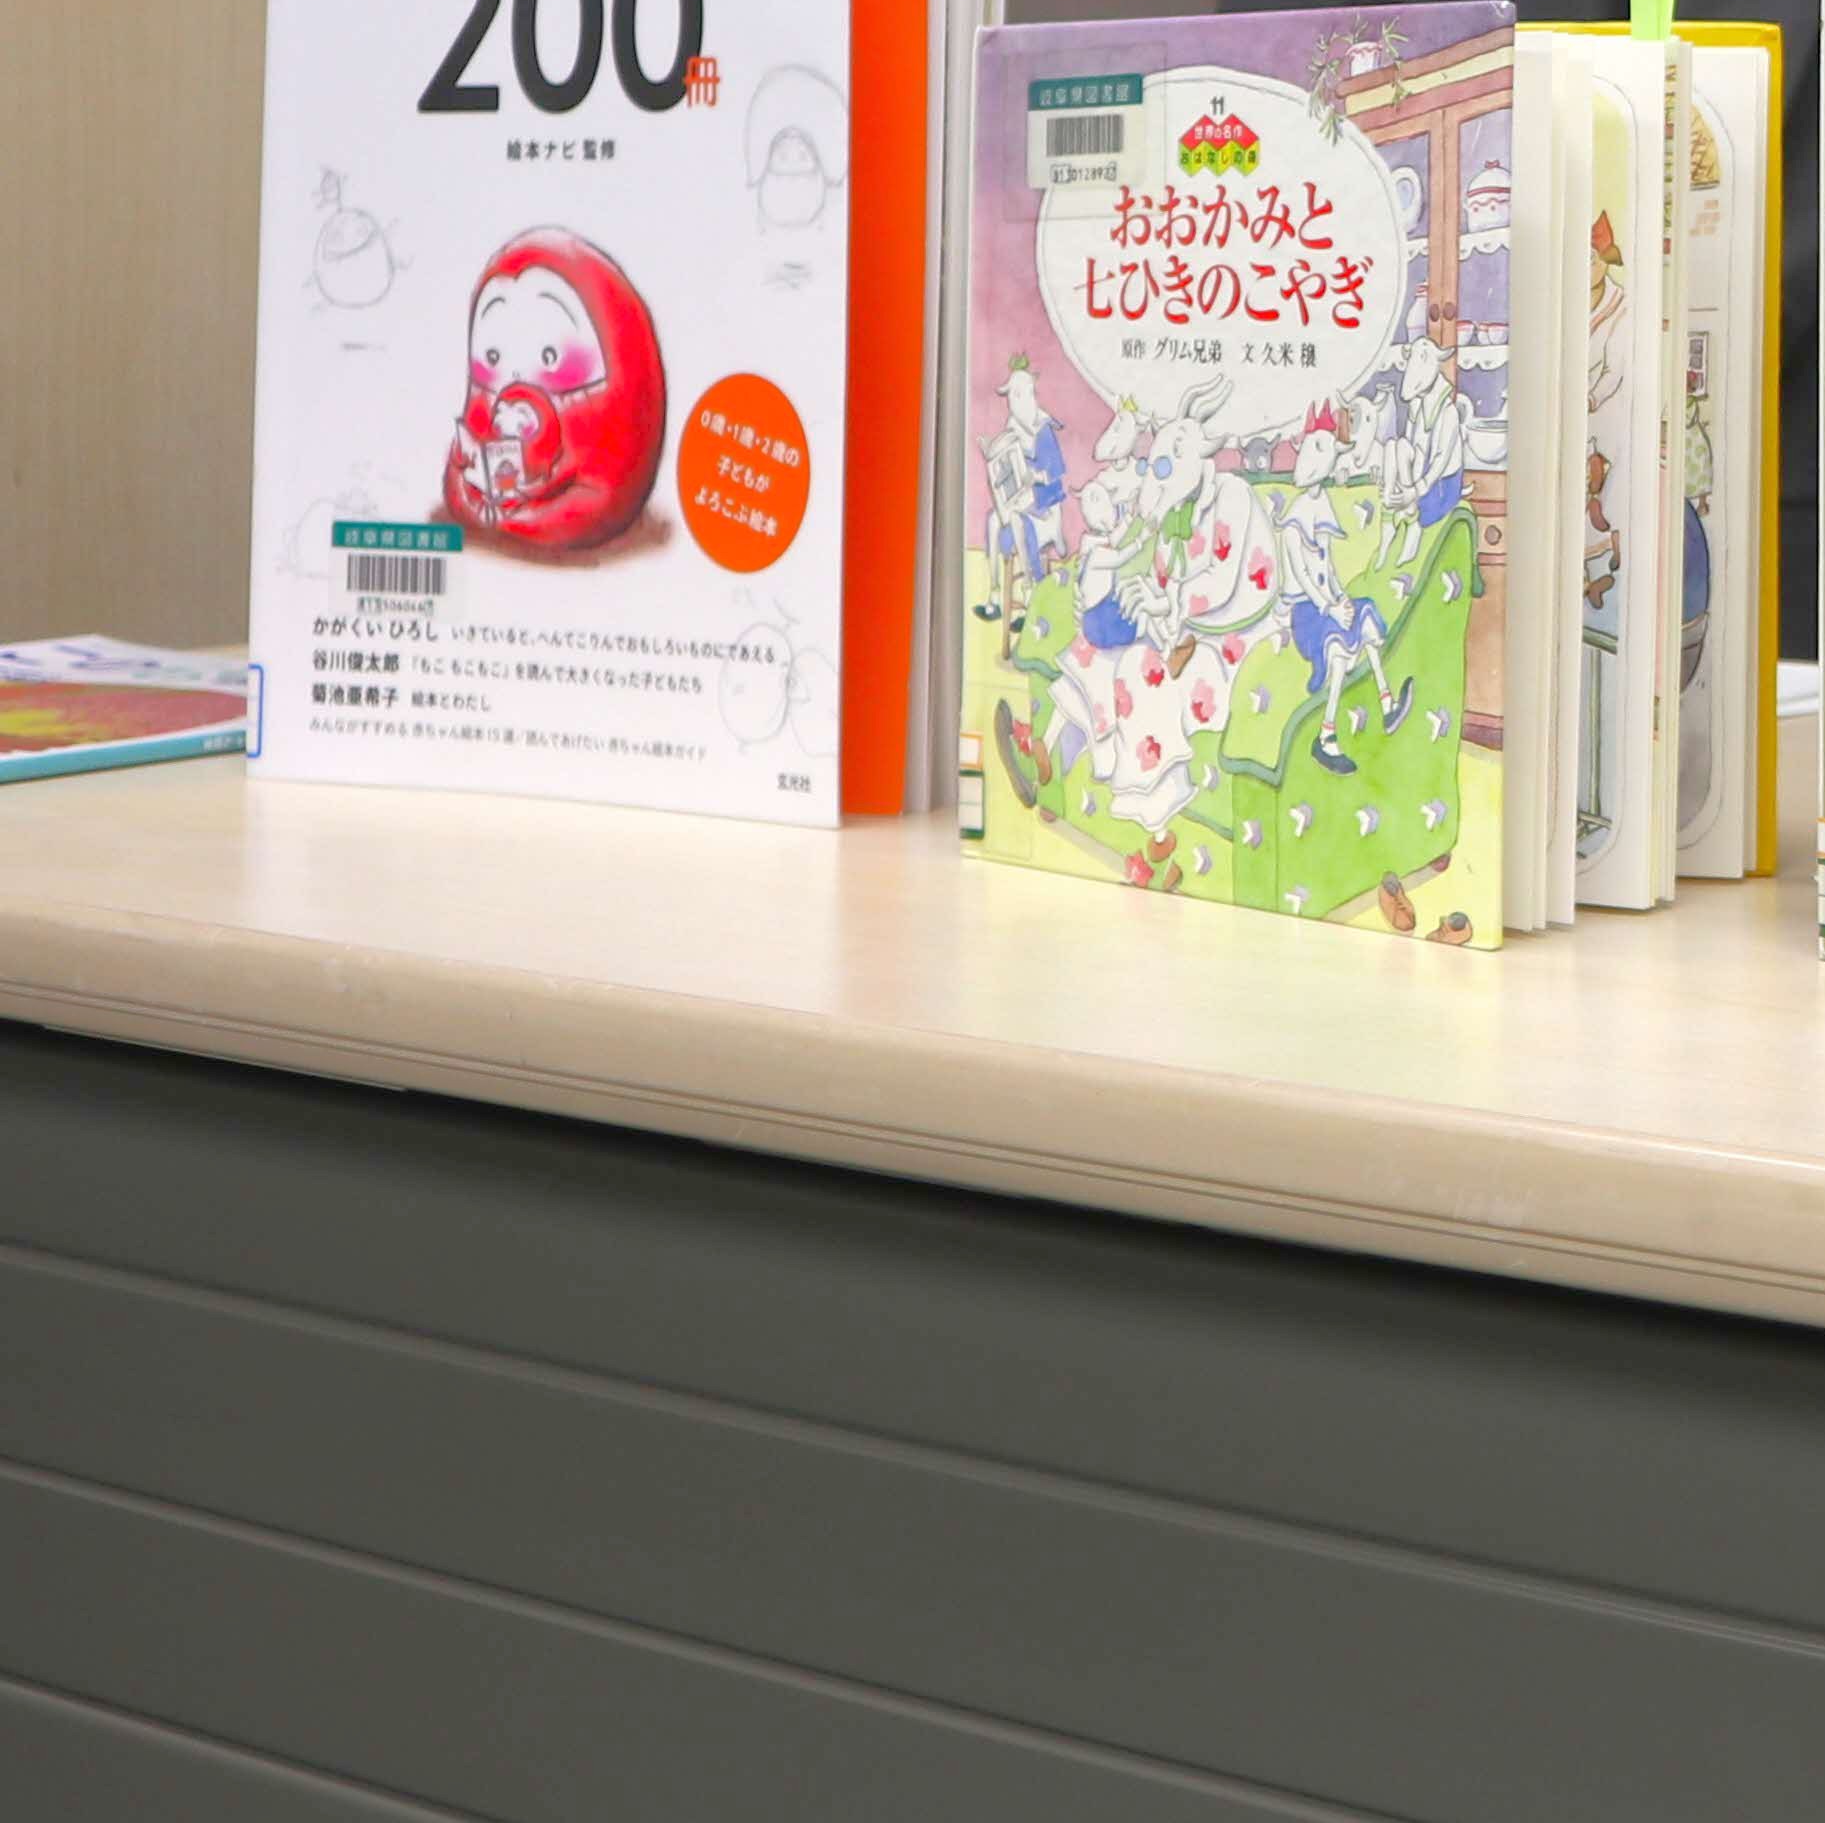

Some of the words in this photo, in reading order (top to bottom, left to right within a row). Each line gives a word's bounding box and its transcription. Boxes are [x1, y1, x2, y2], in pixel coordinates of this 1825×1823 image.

[1040, 84, 1131, 105] 岐阜県図書館
[1194, 125, 1243, 140] 世界の名作
[506, 139, 576, 163] 絵本ナビ
[582, 138, 616, 161] 監修
[1109, 182, 1336, 252] おおかみと
[1075, 252, 1373, 330] 七ひきのこやぎ
[1121, 338, 1146, 359] 原作
[1154, 336, 1222, 364] グリム兄弟
[1241, 342, 1255, 364] 文
[716, 454, 770, 493] 子どもが
[694, 487, 779, 537] よろこぶ絵本
[313, 617, 383, 638] かがくい
[390, 619, 439, 641] ひろし
[313, 649, 400, 674] 谷川俊太郎
[312, 682, 399, 709] 菊池亜希子
[411, 690, 491, 712] 絵本とわたし
